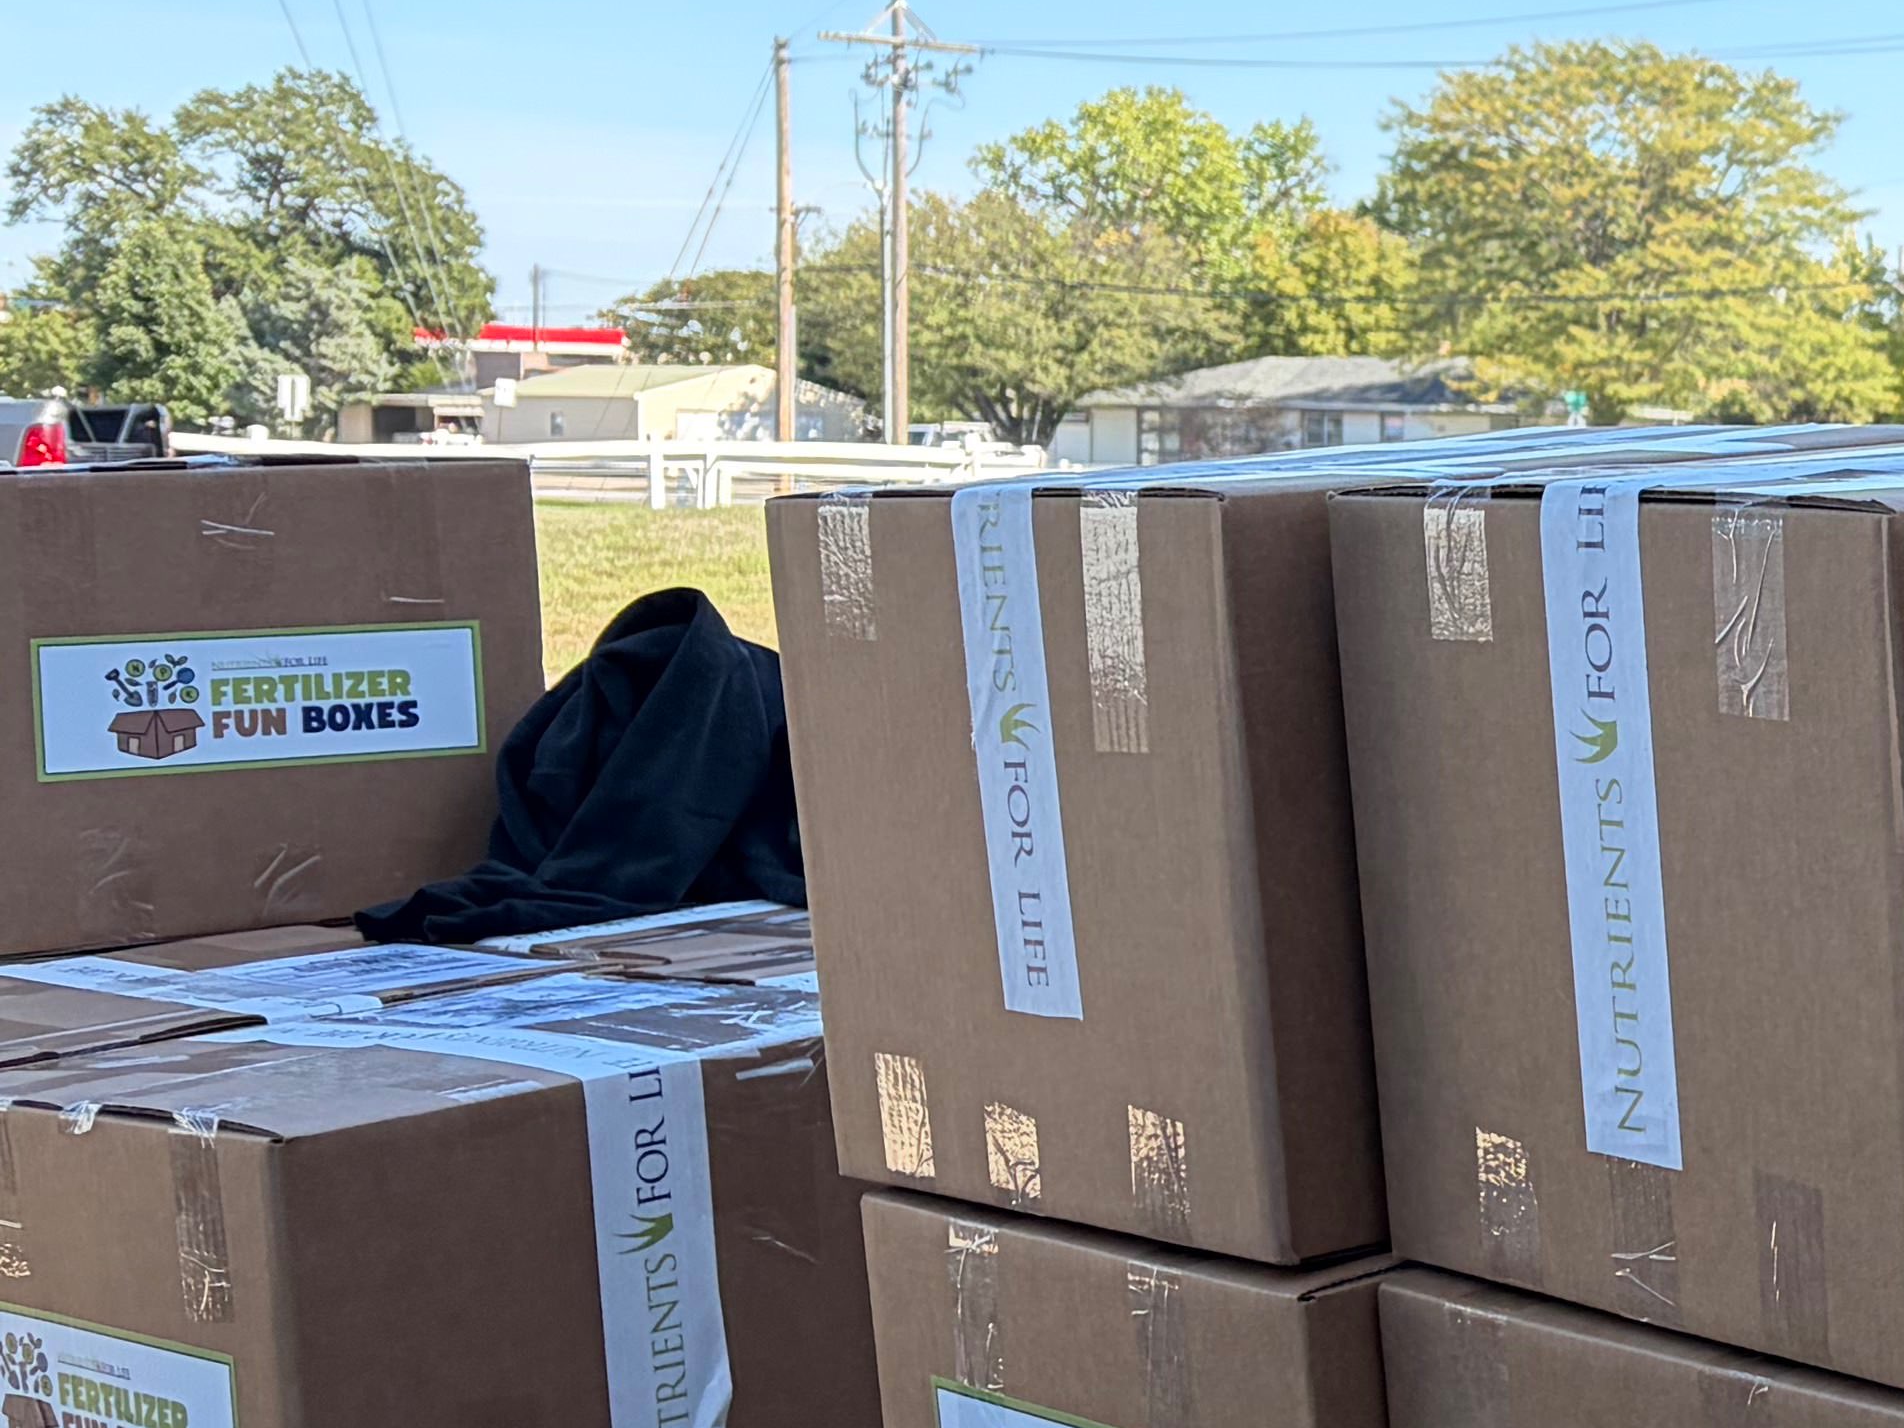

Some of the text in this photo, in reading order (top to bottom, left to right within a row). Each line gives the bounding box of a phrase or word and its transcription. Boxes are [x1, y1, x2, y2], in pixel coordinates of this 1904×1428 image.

[211, 668, 412, 707] FERTILIZER
[1580, 575, 1617, 701] FOR
[212, 700, 420, 739] FUN BOXES
[976, 499, 1050, 989] RIENTS FOR LIFE
[1597, 776, 1647, 1136] NUTRIENTS
[633, 1114, 673, 1208] FOR
